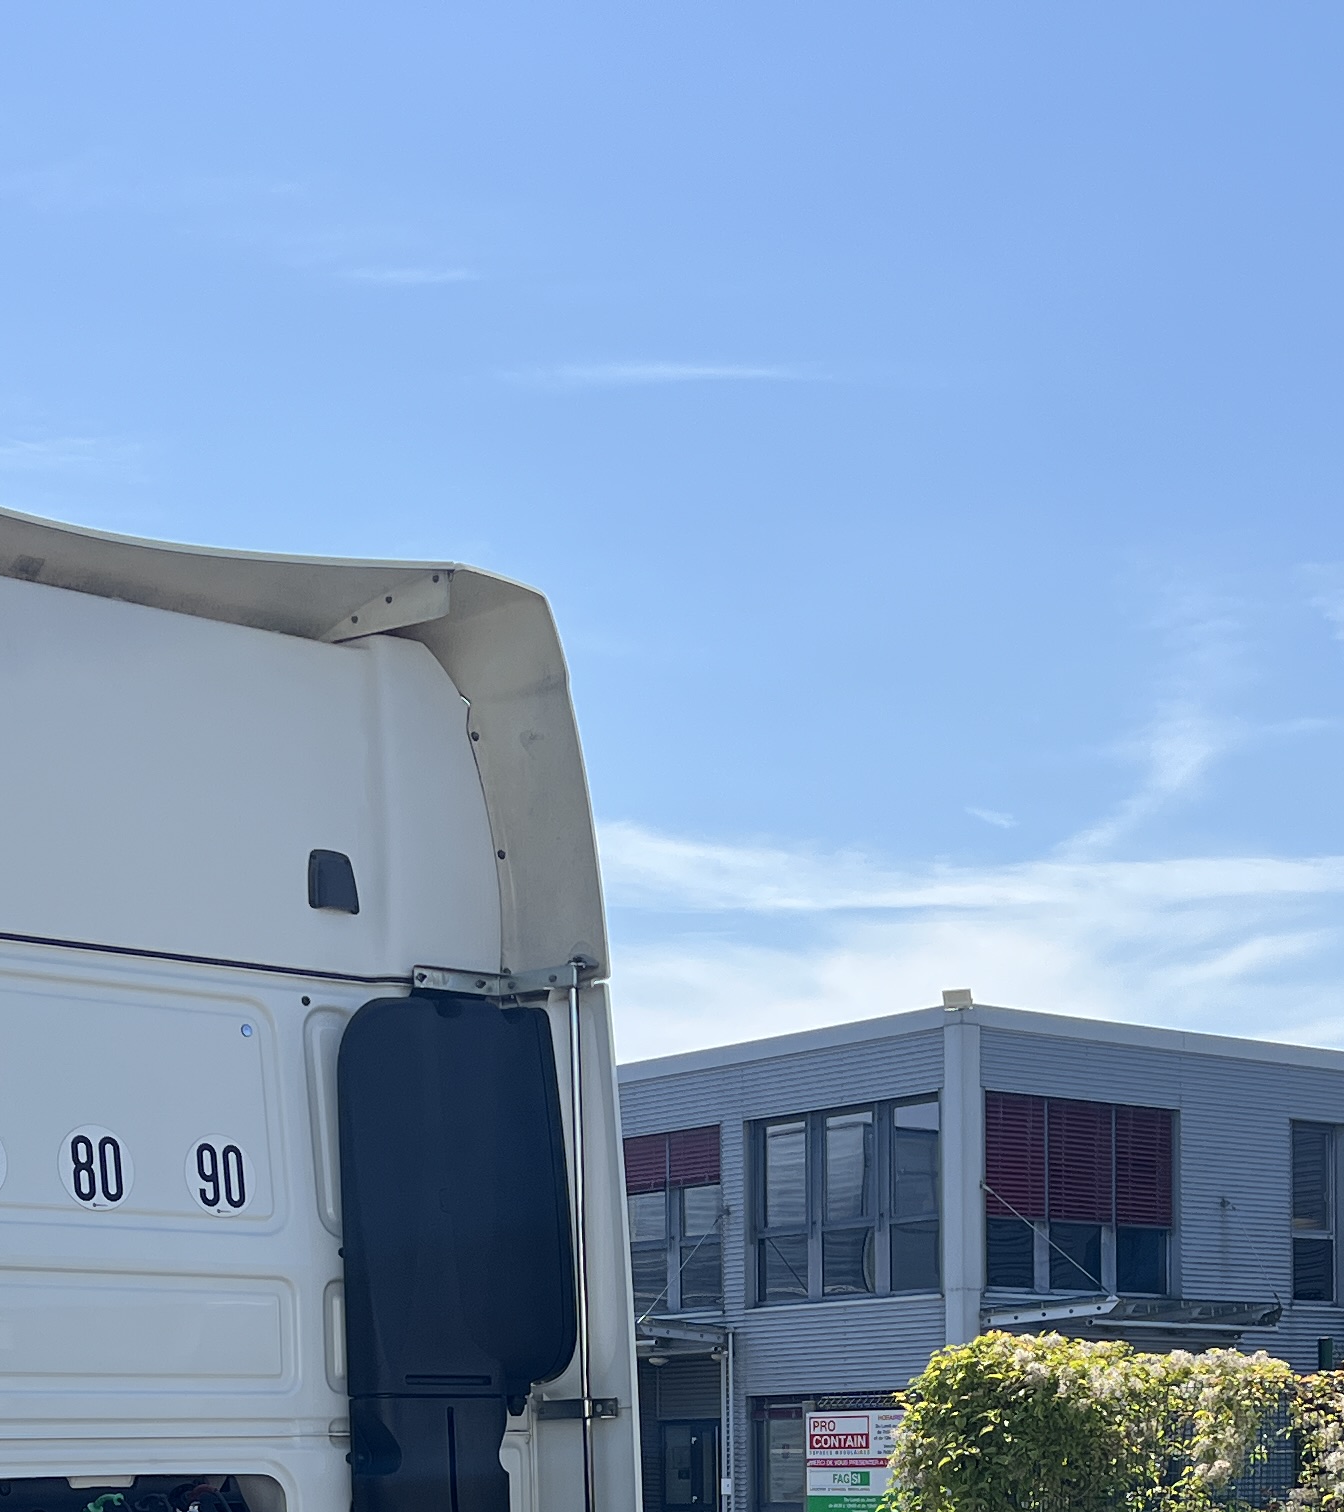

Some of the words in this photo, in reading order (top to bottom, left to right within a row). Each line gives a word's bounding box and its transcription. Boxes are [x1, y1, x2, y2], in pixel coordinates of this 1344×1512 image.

[71, 1135, 123, 1202] 80
[195, 1142, 246, 1209] 90
[812, 1420, 836, 1432] PRO
[812, 1434, 867, 1448] CONTAIN
